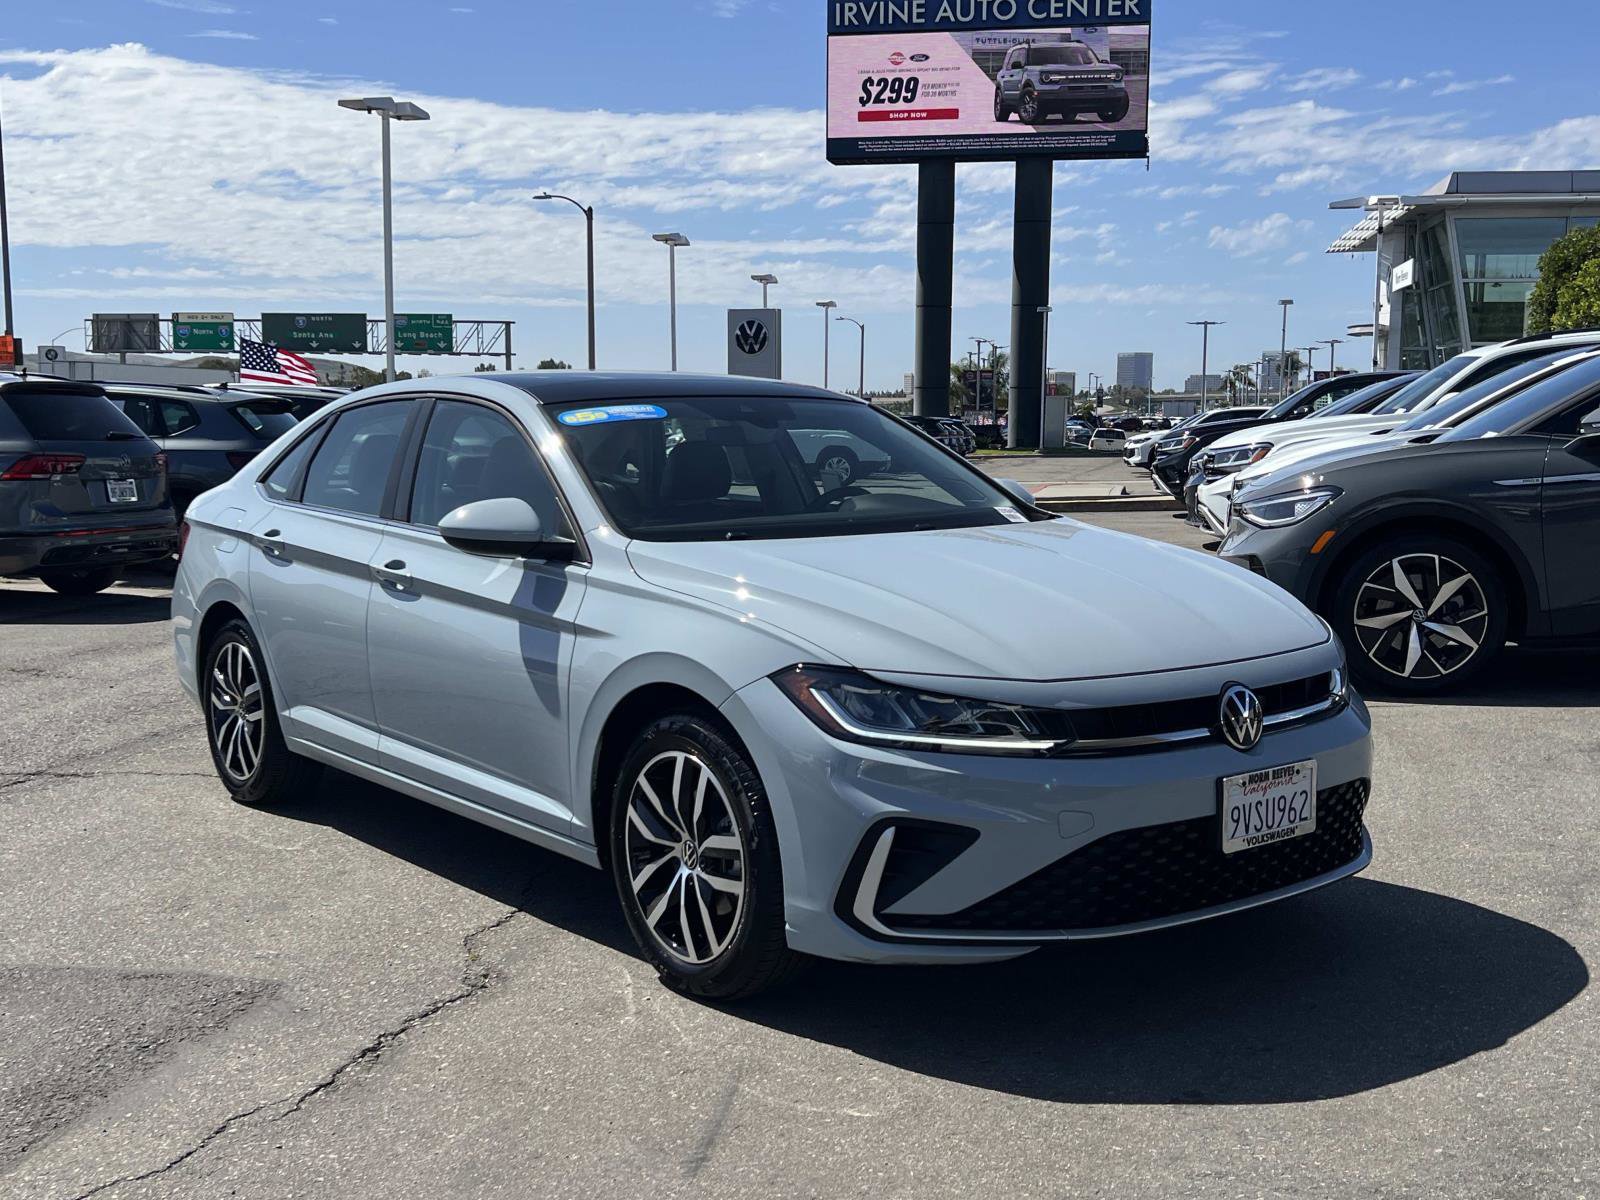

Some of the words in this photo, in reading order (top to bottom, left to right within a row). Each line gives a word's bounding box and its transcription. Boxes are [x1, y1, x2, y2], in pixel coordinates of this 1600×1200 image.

[835, 0, 926, 26] IRVINE
[934, 0, 1017, 22] AUTO
[1027, 0, 1141, 19] CENTER
[859, 76, 920, 107] $299
[292, 331, 315, 339] Santa
[318, 331, 334, 339] Ana
[398, 331, 417, 340] Long
[1248, 771, 1270, 785] NORM
[1271, 766, 1295, 780] REEVES
[1242, 776, 1298, 797] California
[1230, 790, 1309, 839] 9VSU962
[1246, 826, 1296, 847] VOLKSWAGEN
